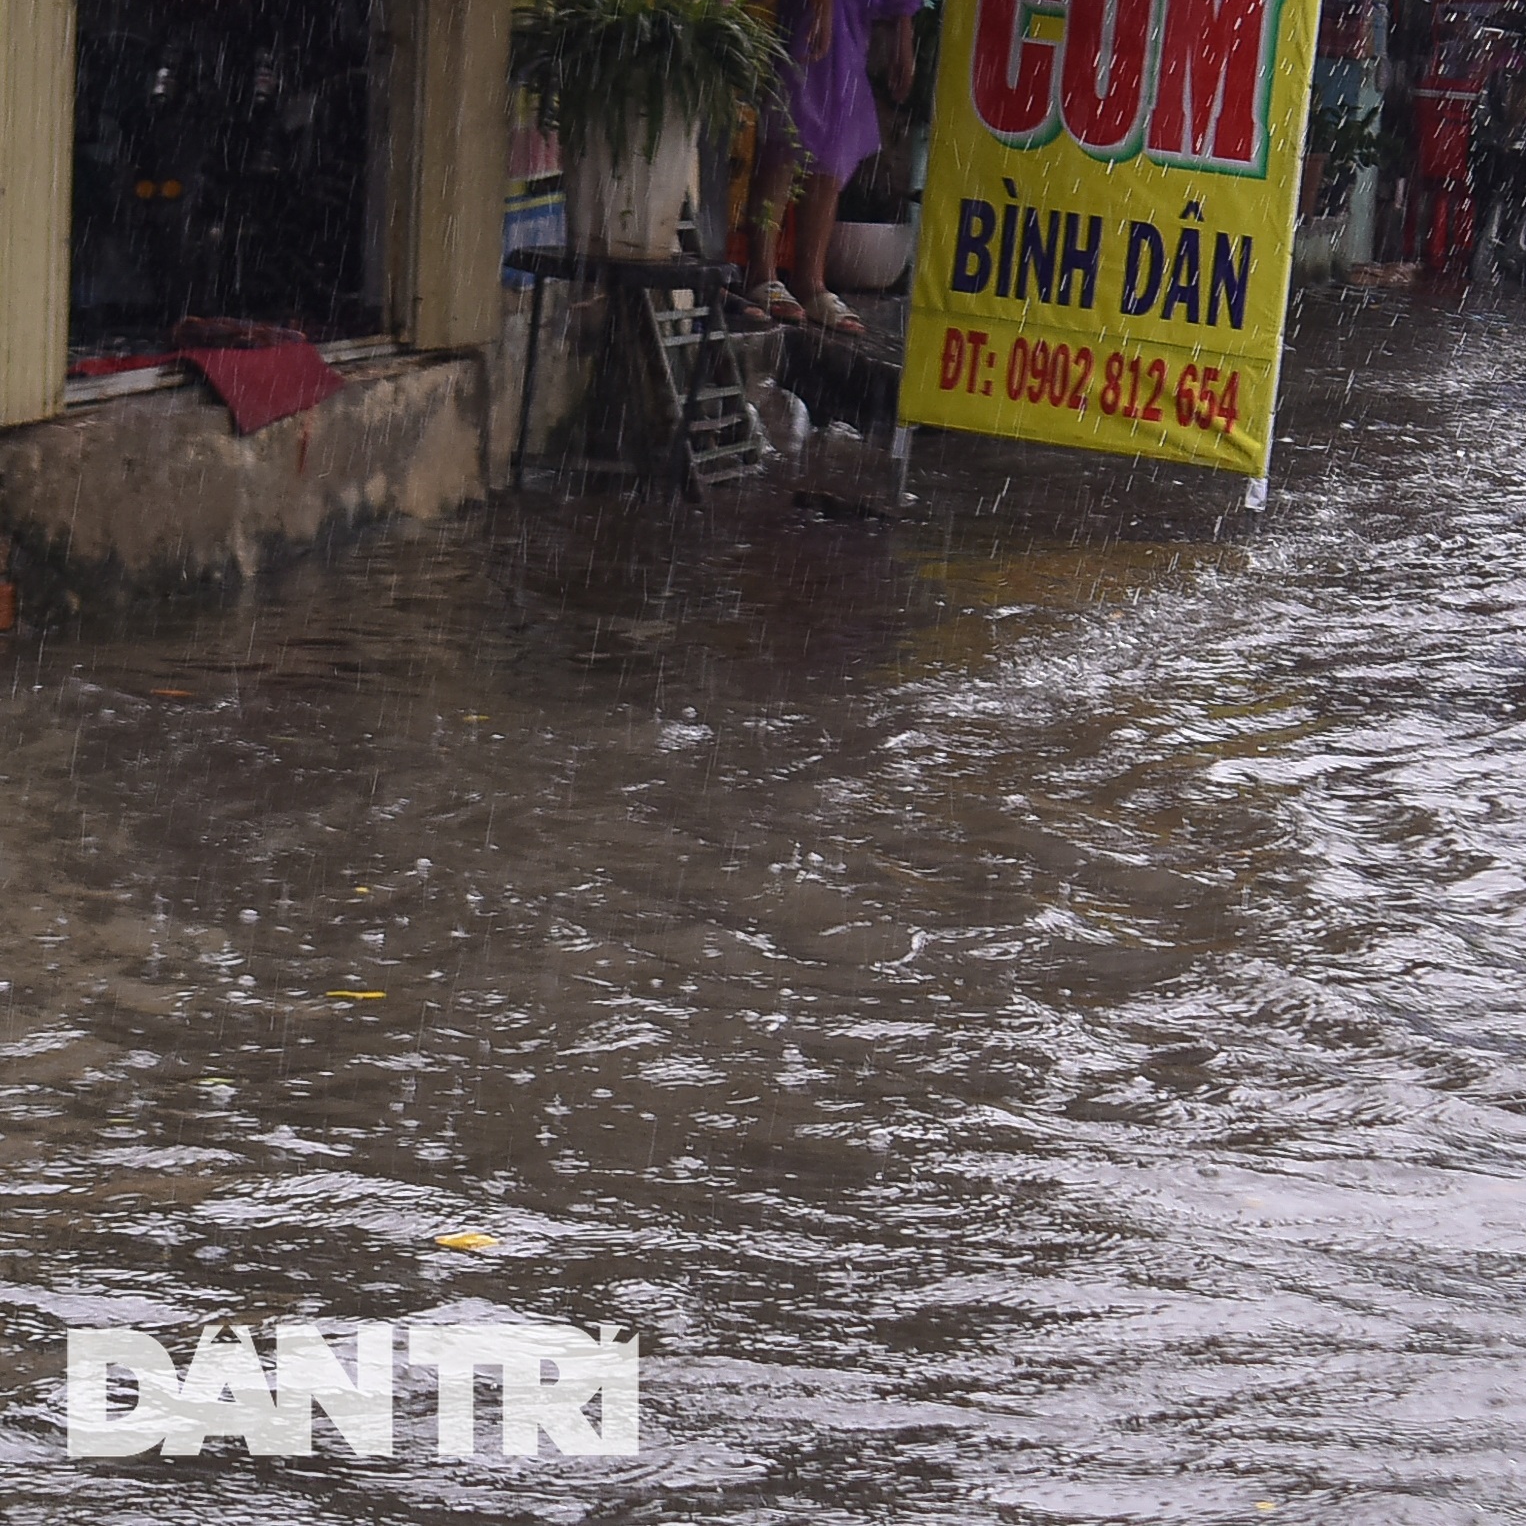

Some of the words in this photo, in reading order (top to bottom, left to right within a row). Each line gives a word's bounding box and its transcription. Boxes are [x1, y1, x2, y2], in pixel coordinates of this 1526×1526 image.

[951, 177, 1103, 310] BÌNH
[1121, 200, 1253, 331] DÂN
[940, 327, 996, 397] ĐT:
[1007, 336, 1094, 411] 0902
[1101, 352, 1168, 422] 812
[1176, 363, 1240, 434] 654
